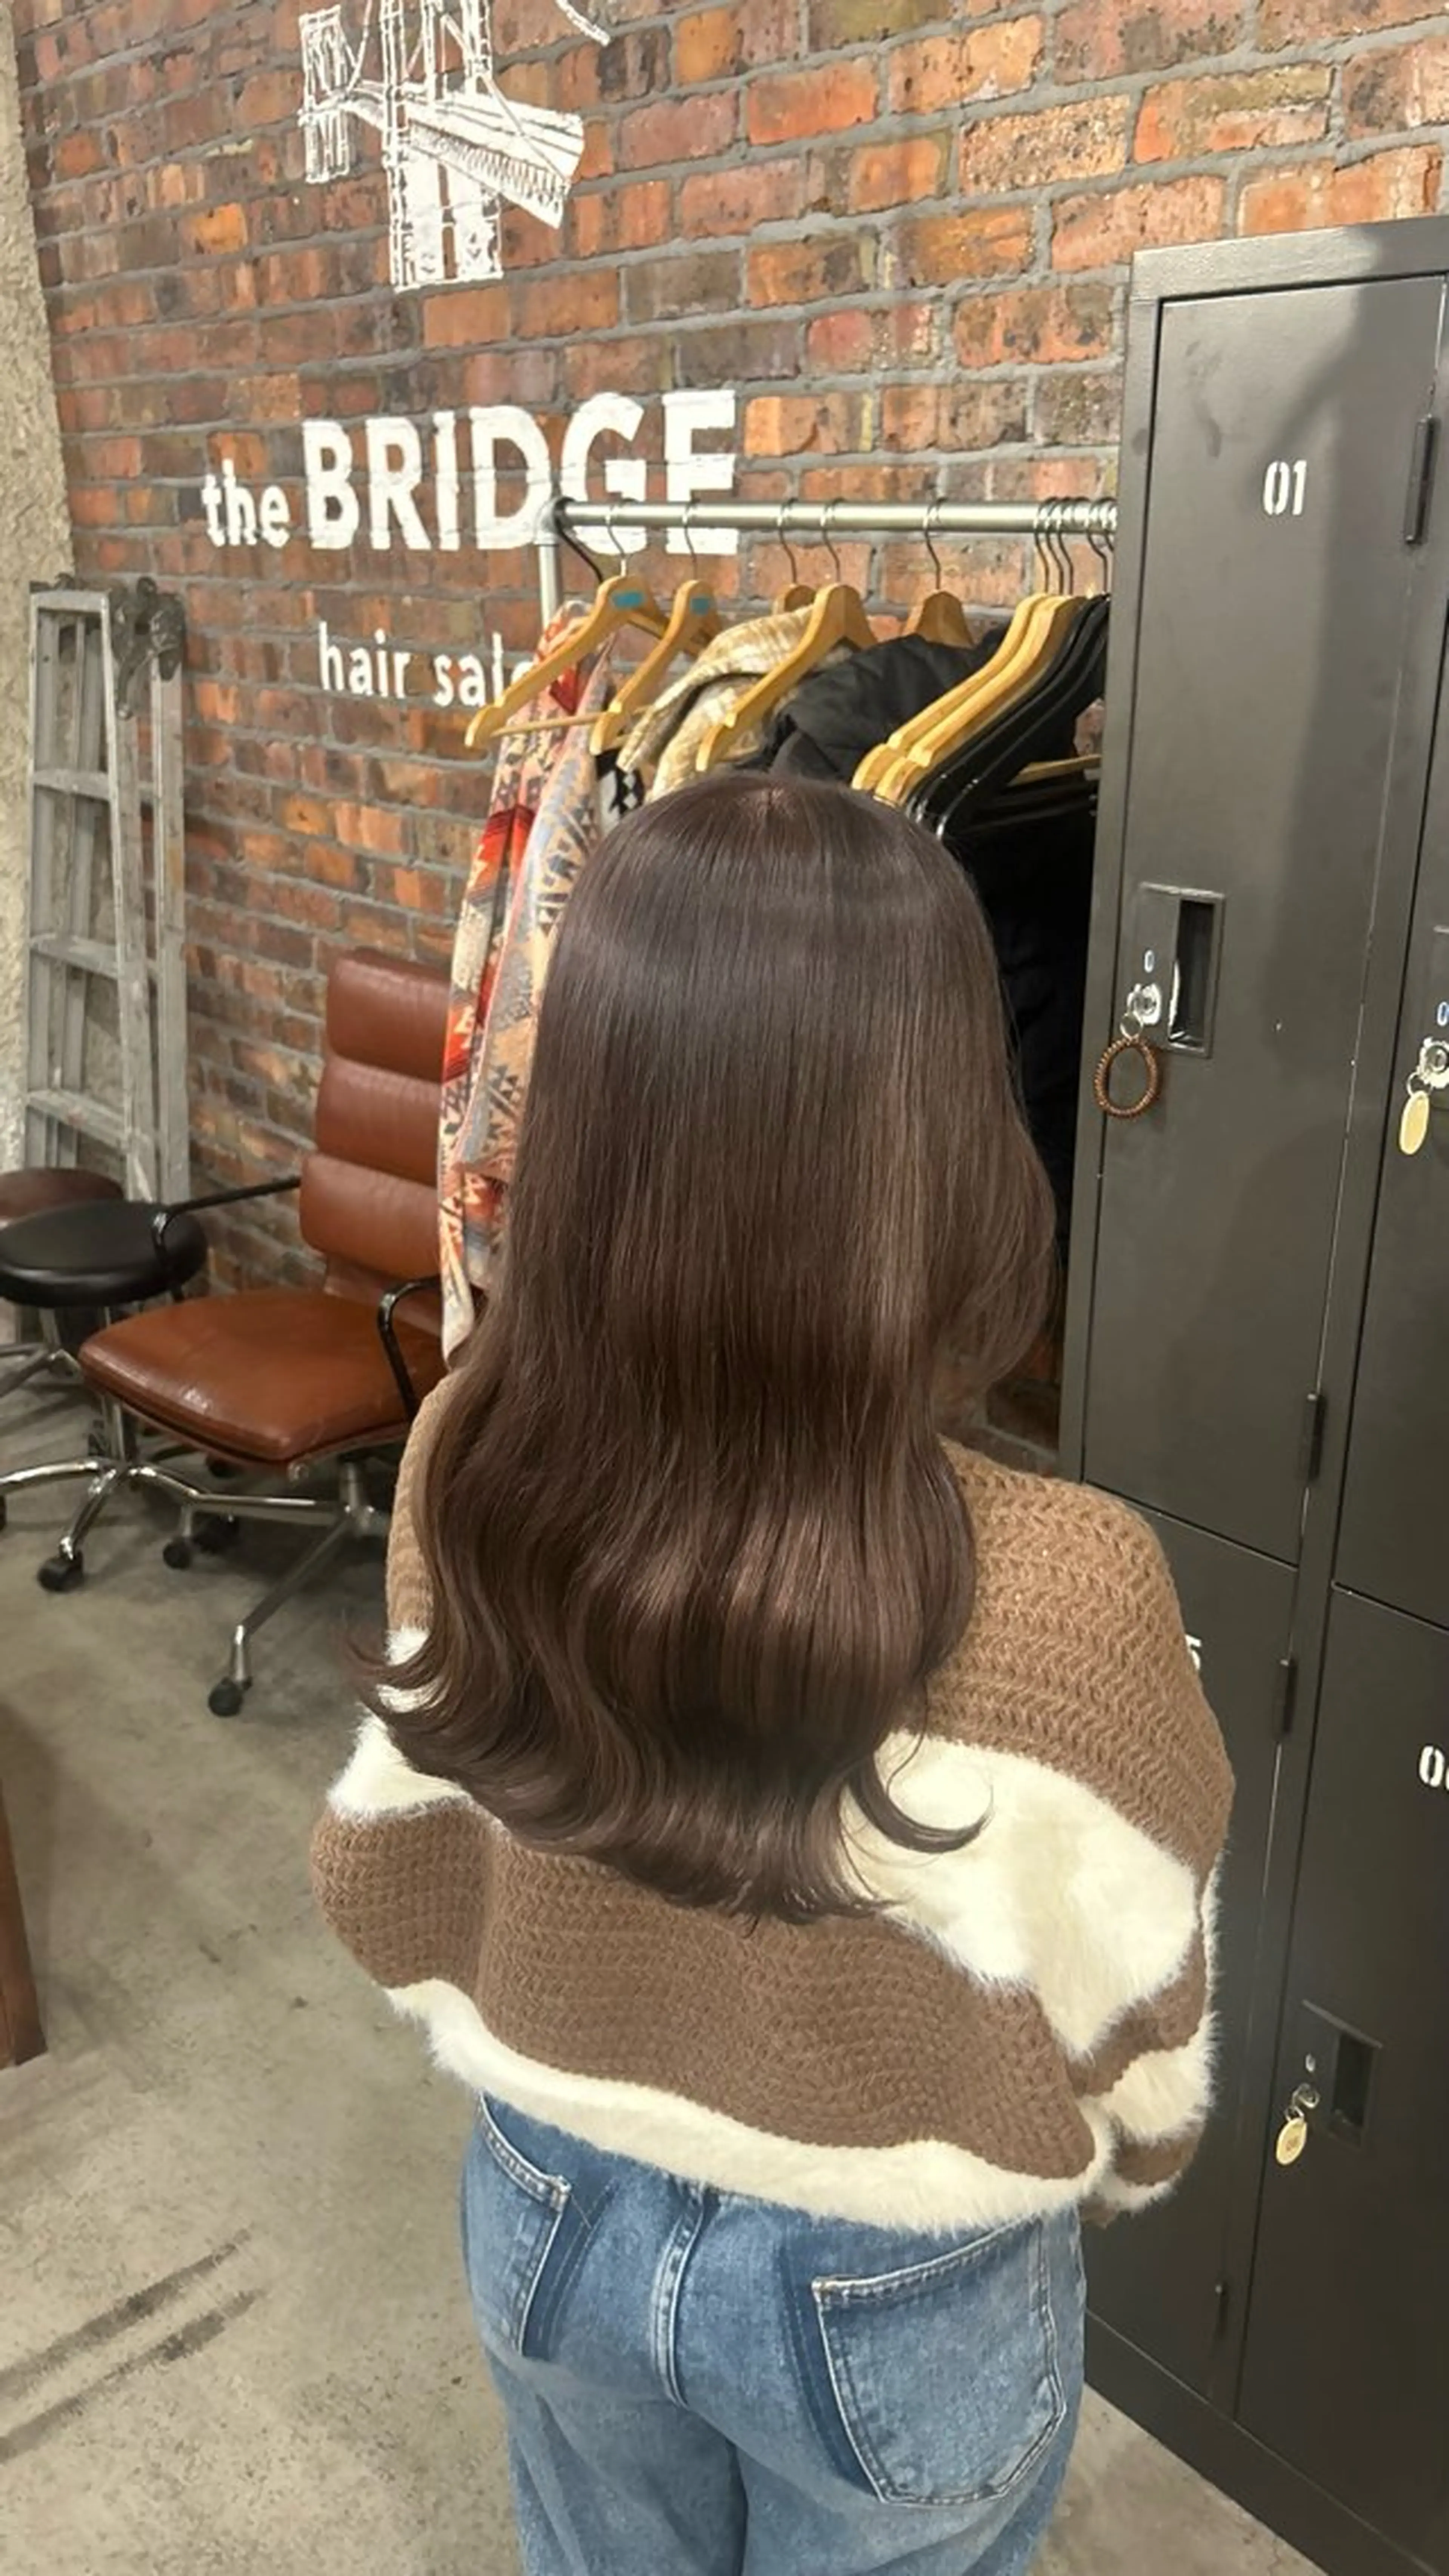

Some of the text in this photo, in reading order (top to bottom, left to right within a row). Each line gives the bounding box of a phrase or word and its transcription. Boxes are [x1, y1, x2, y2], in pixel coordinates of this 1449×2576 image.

[201, 388, 738, 556] the BRIDGE
[1263, 460, 1307, 515] 01
[318, 621, 411, 699] hair
[1419, 1745, 1449, 1790] 0
